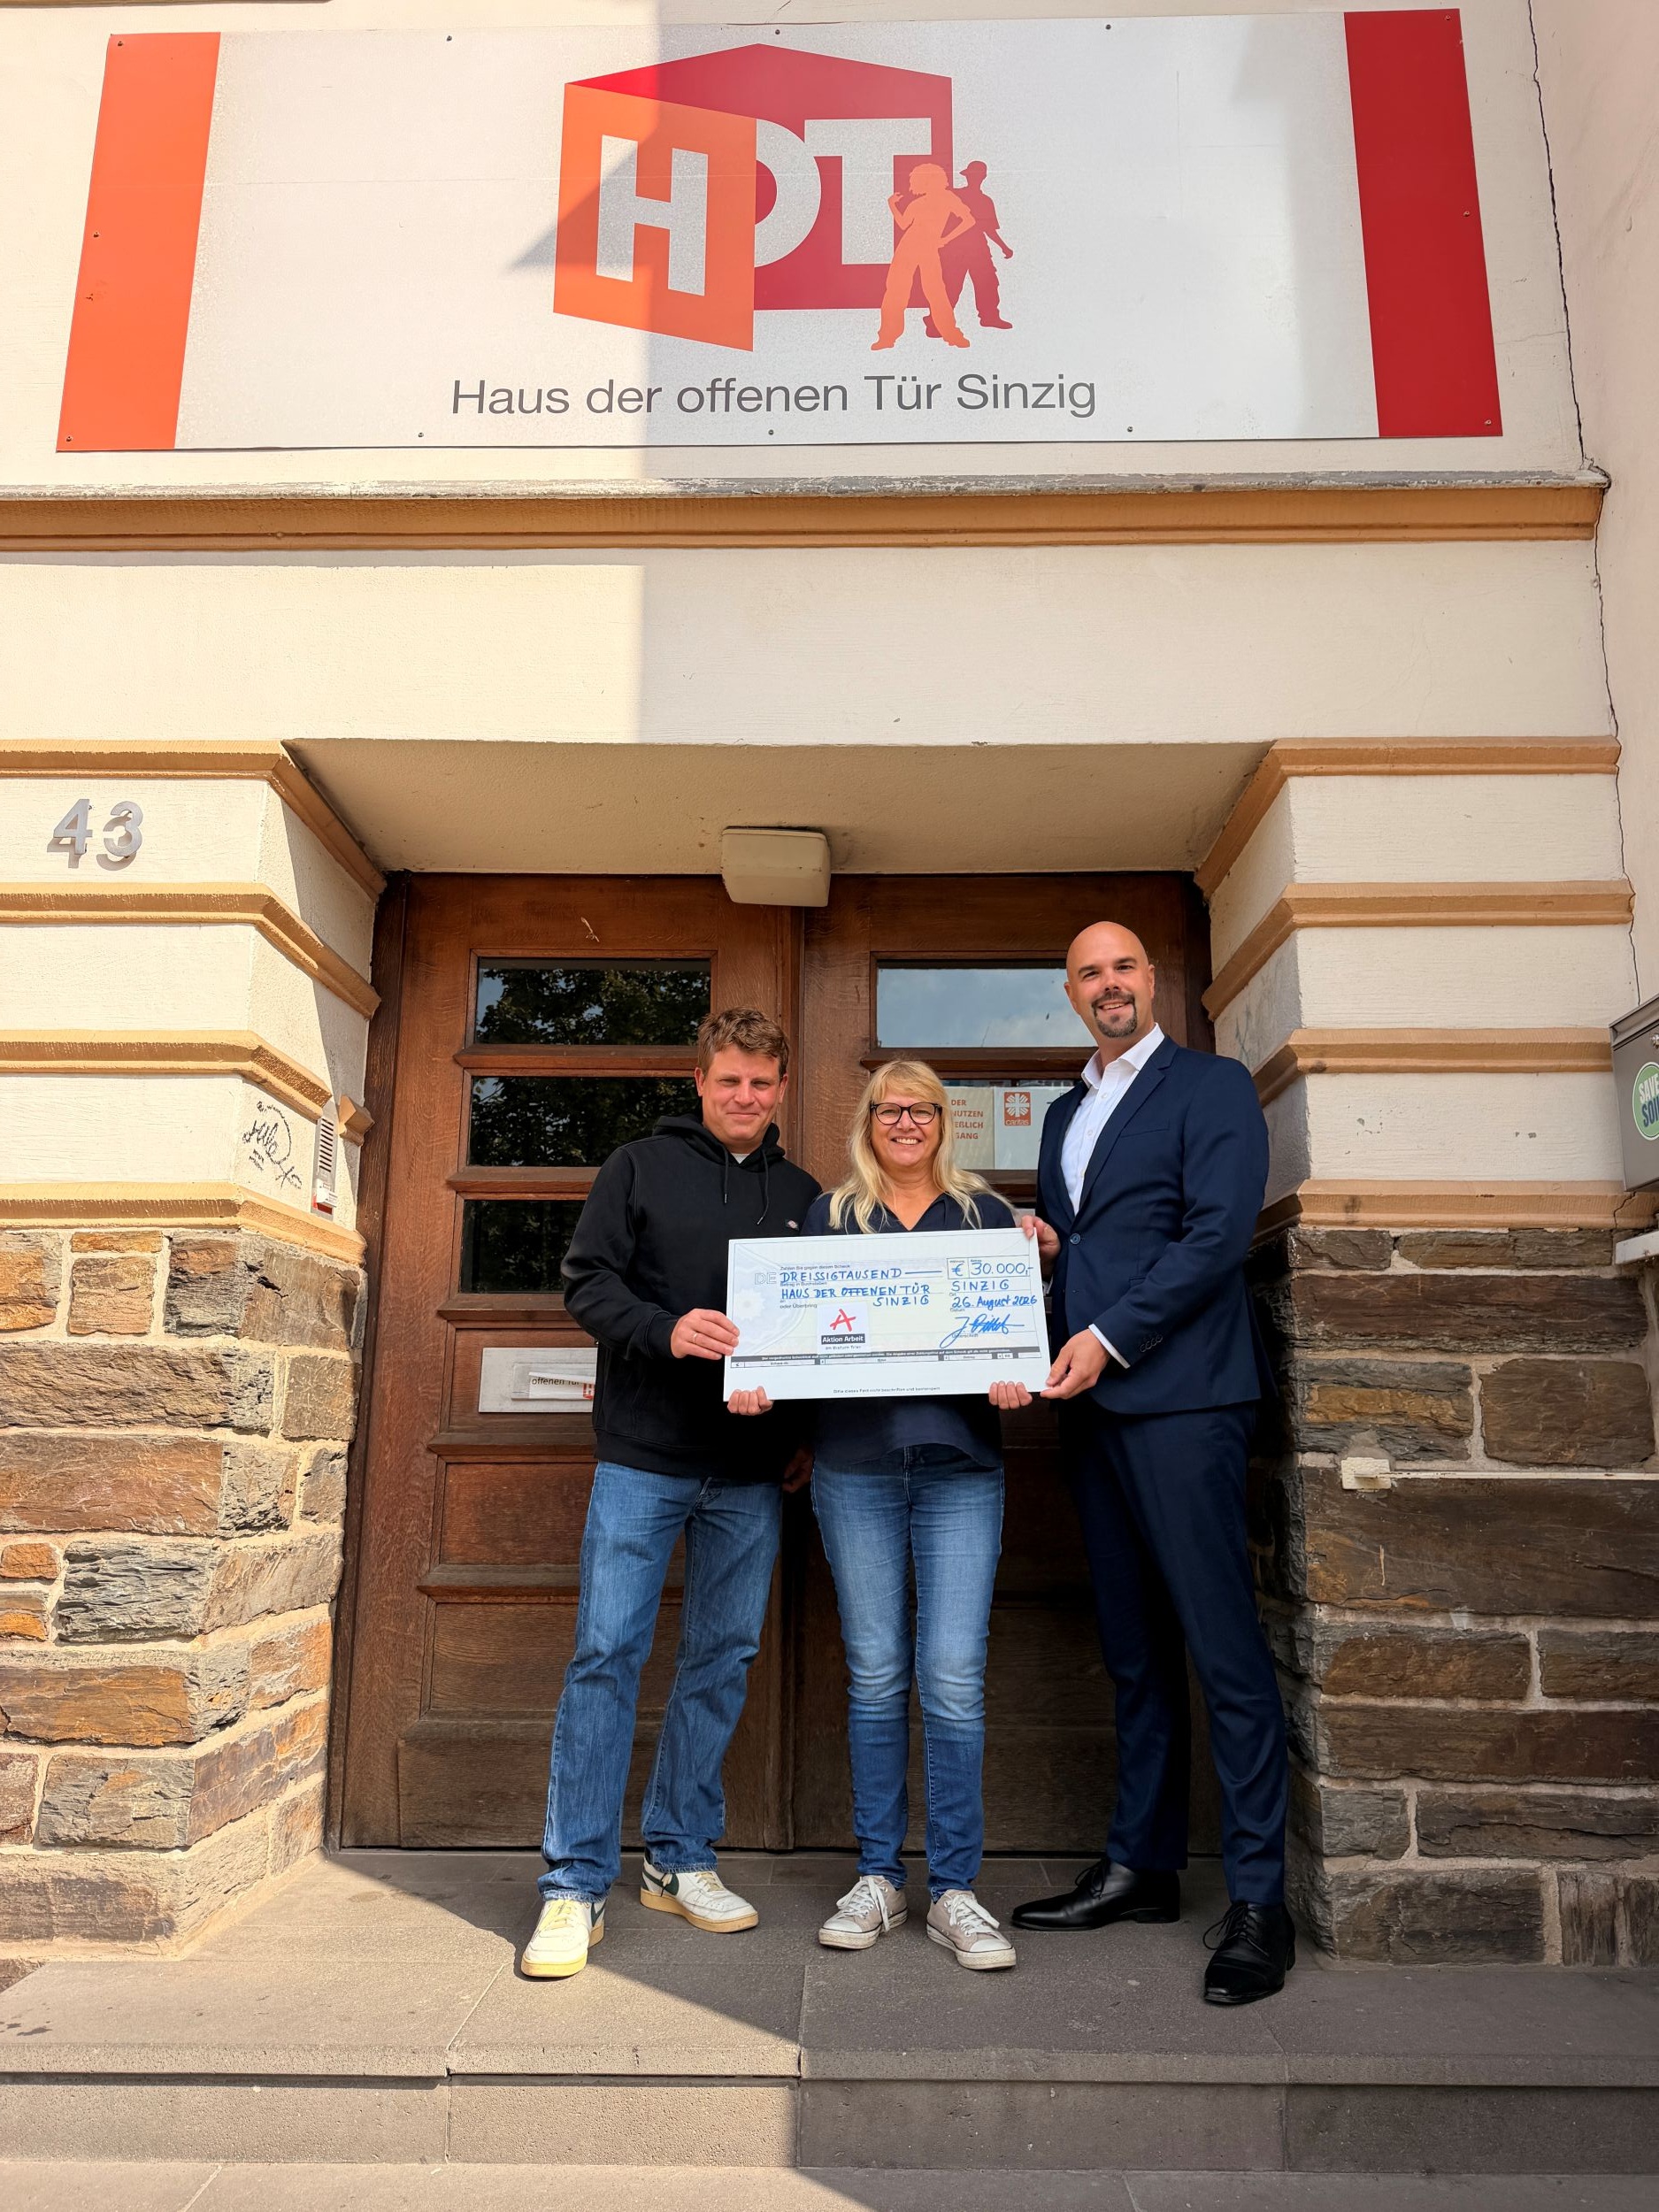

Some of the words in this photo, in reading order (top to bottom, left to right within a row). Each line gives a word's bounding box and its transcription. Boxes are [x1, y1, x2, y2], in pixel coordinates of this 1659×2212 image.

[452, 379, 571, 414] Haus
[586, 378, 663, 414] der
[676, 377, 849, 414] offenen
[864, 374, 942, 411] Tür
[956, 373, 1096, 419] Sinzig
[52, 798, 144, 857] 43
[1642, 1095, 1659, 1127] SOI
[780, 1268, 902, 1283] DREISSIGTAUSEND
[781, 1287, 810, 1300] HAUS
[813, 1288, 837, 1298] DER
[841, 1285, 897, 1297] OFFENEN
[899, 1282, 931, 1295] TÜR
[950, 1279, 1010, 1292] SINZIG
[872, 1294, 929, 1307] SINZIG
[976, 1294, 1011, 1311] August
